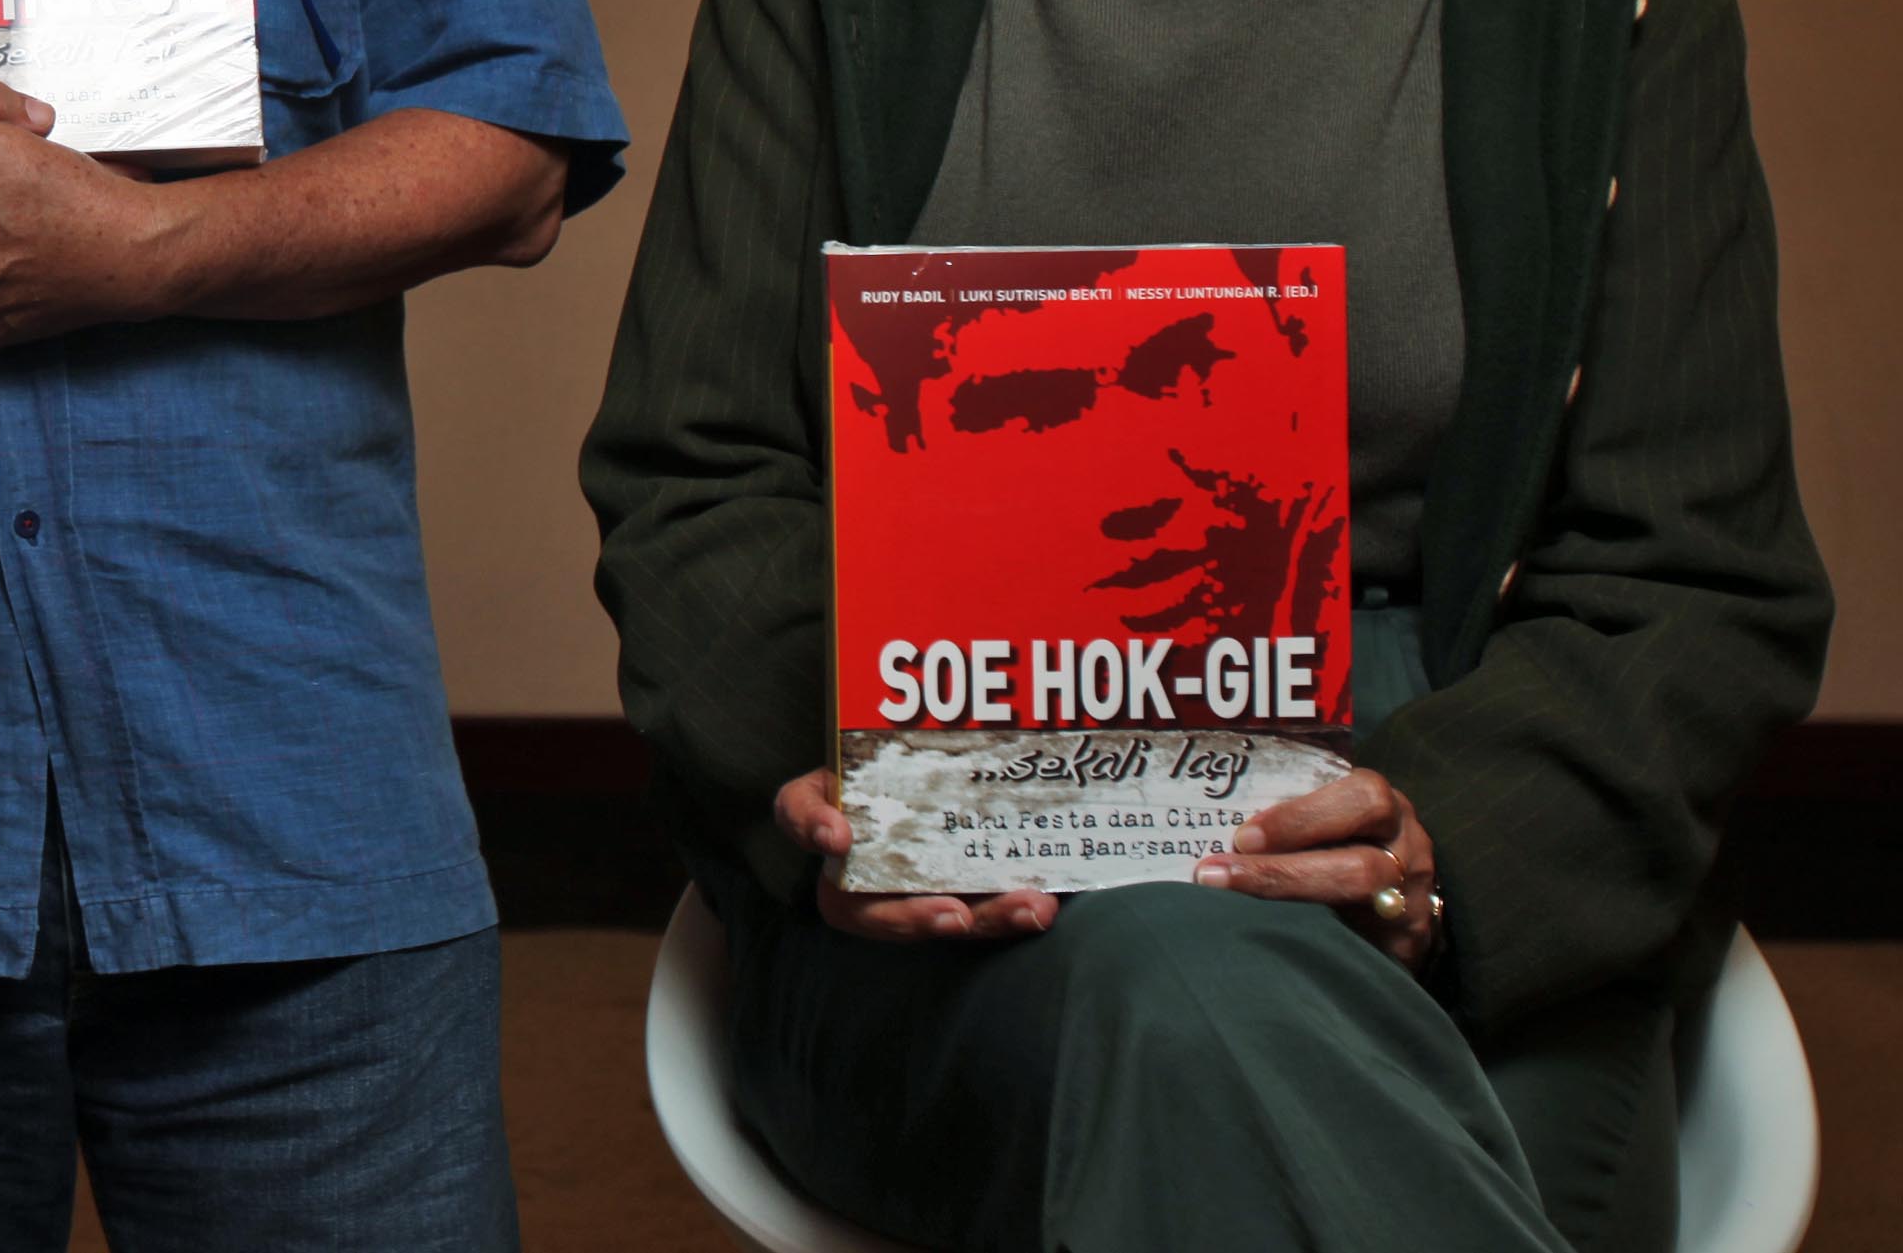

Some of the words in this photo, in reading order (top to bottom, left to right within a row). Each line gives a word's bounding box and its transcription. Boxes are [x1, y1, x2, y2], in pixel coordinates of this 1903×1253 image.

[861, 291, 900, 304] RUDY
[903, 290, 946, 303] BADIL
[959, 289, 993, 302] LUKI
[996, 288, 1067, 302] SUTRISNO
[1070, 288, 1113, 301] BEKTI
[1127, 287, 1173, 300] NESSY
[1177, 286, 1265, 299] LUNTUNGAN
[1268, 286, 1282, 298] R.
[878, 639, 1012, 722] SOE
[1032, 636, 1316, 722] HOK-GIE
[1169, 736, 1255, 799] lagi
[942, 810, 1008, 834] Buku
[1107, 808, 1155, 829] dan
[1167, 807, 1246, 830] Cinta
[964, 838, 993, 861] di
[1005, 838, 1072, 859] Alam
[1080, 837, 1226, 861] Bangsanya
